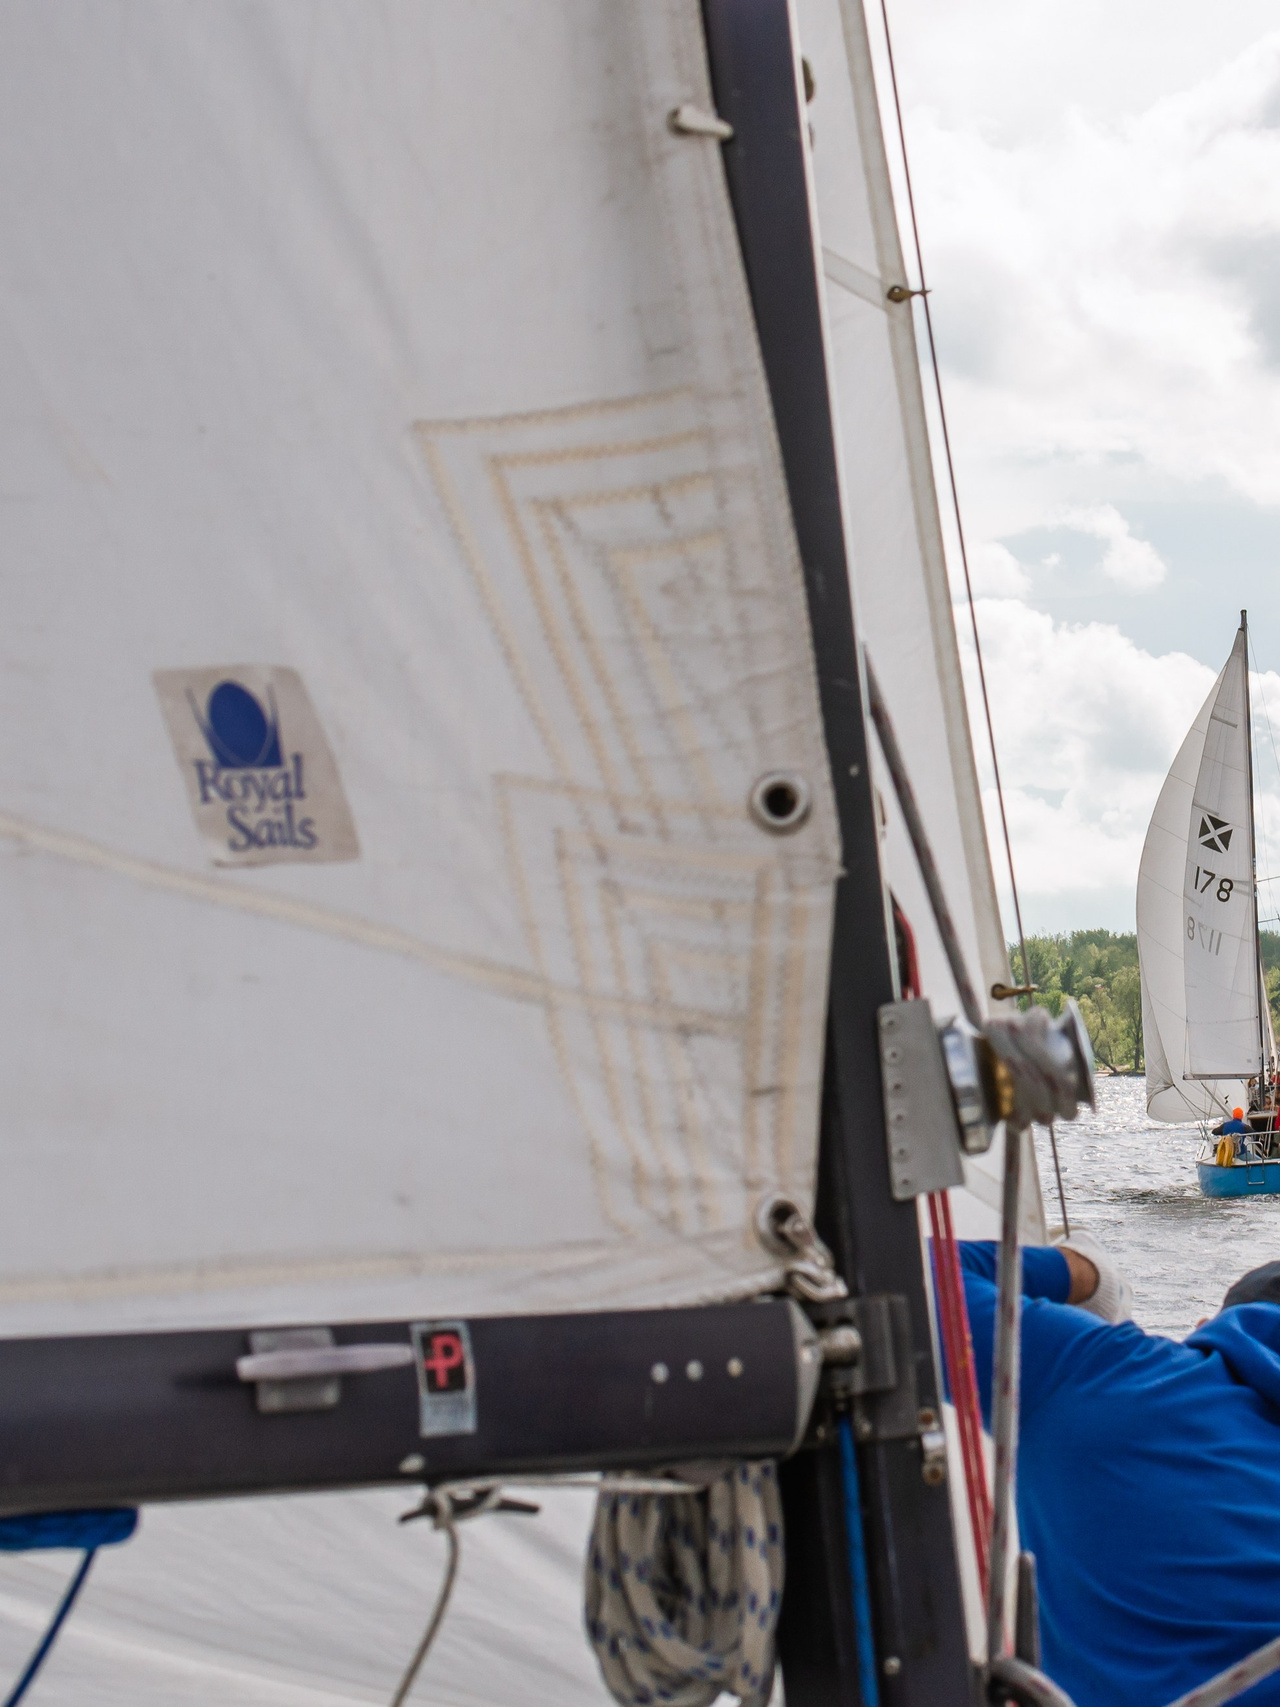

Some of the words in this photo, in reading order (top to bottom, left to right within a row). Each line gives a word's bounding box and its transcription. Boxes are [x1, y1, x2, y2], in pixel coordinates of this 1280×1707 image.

[194, 752, 306, 813] Royal
[227, 802, 319, 852] Sails
[1194, 866, 1234, 902] 178
